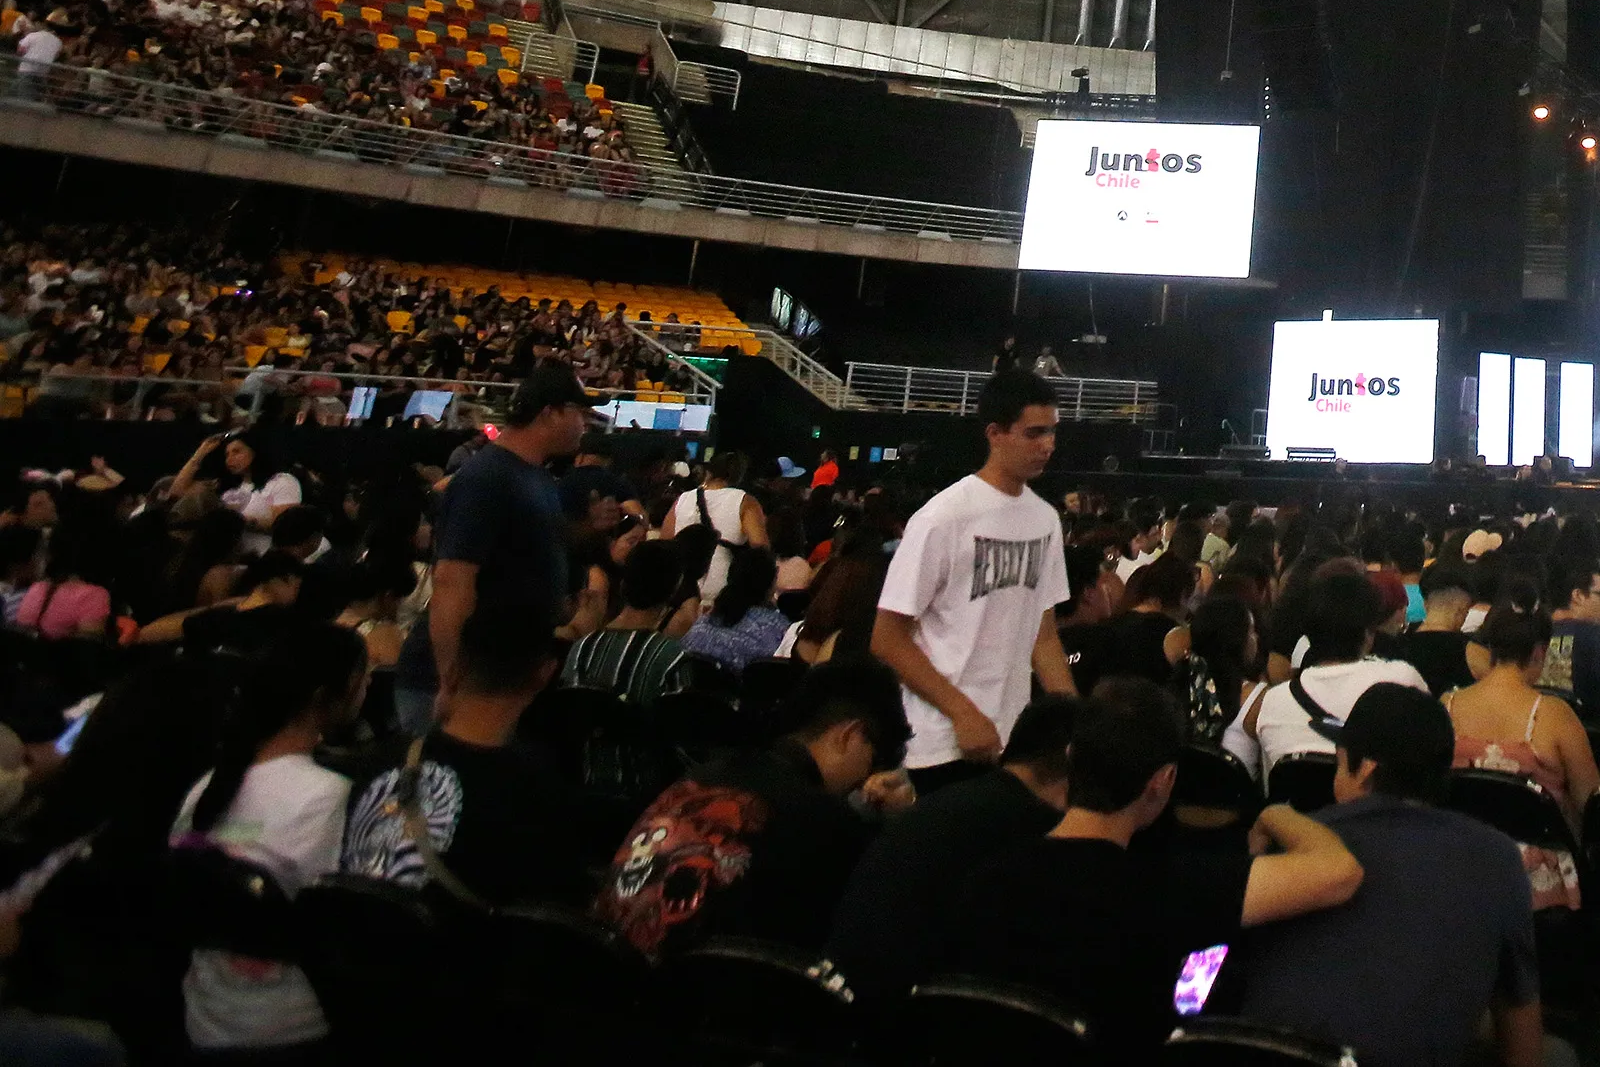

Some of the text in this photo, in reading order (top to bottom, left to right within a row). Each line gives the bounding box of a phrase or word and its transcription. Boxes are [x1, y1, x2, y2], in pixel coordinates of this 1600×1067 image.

[1085, 146, 1202, 176] Juntos
[1095, 173, 1140, 189] Chile
[1308, 373, 1401, 401] Juntos
[1316, 398, 1352, 413] Chile
